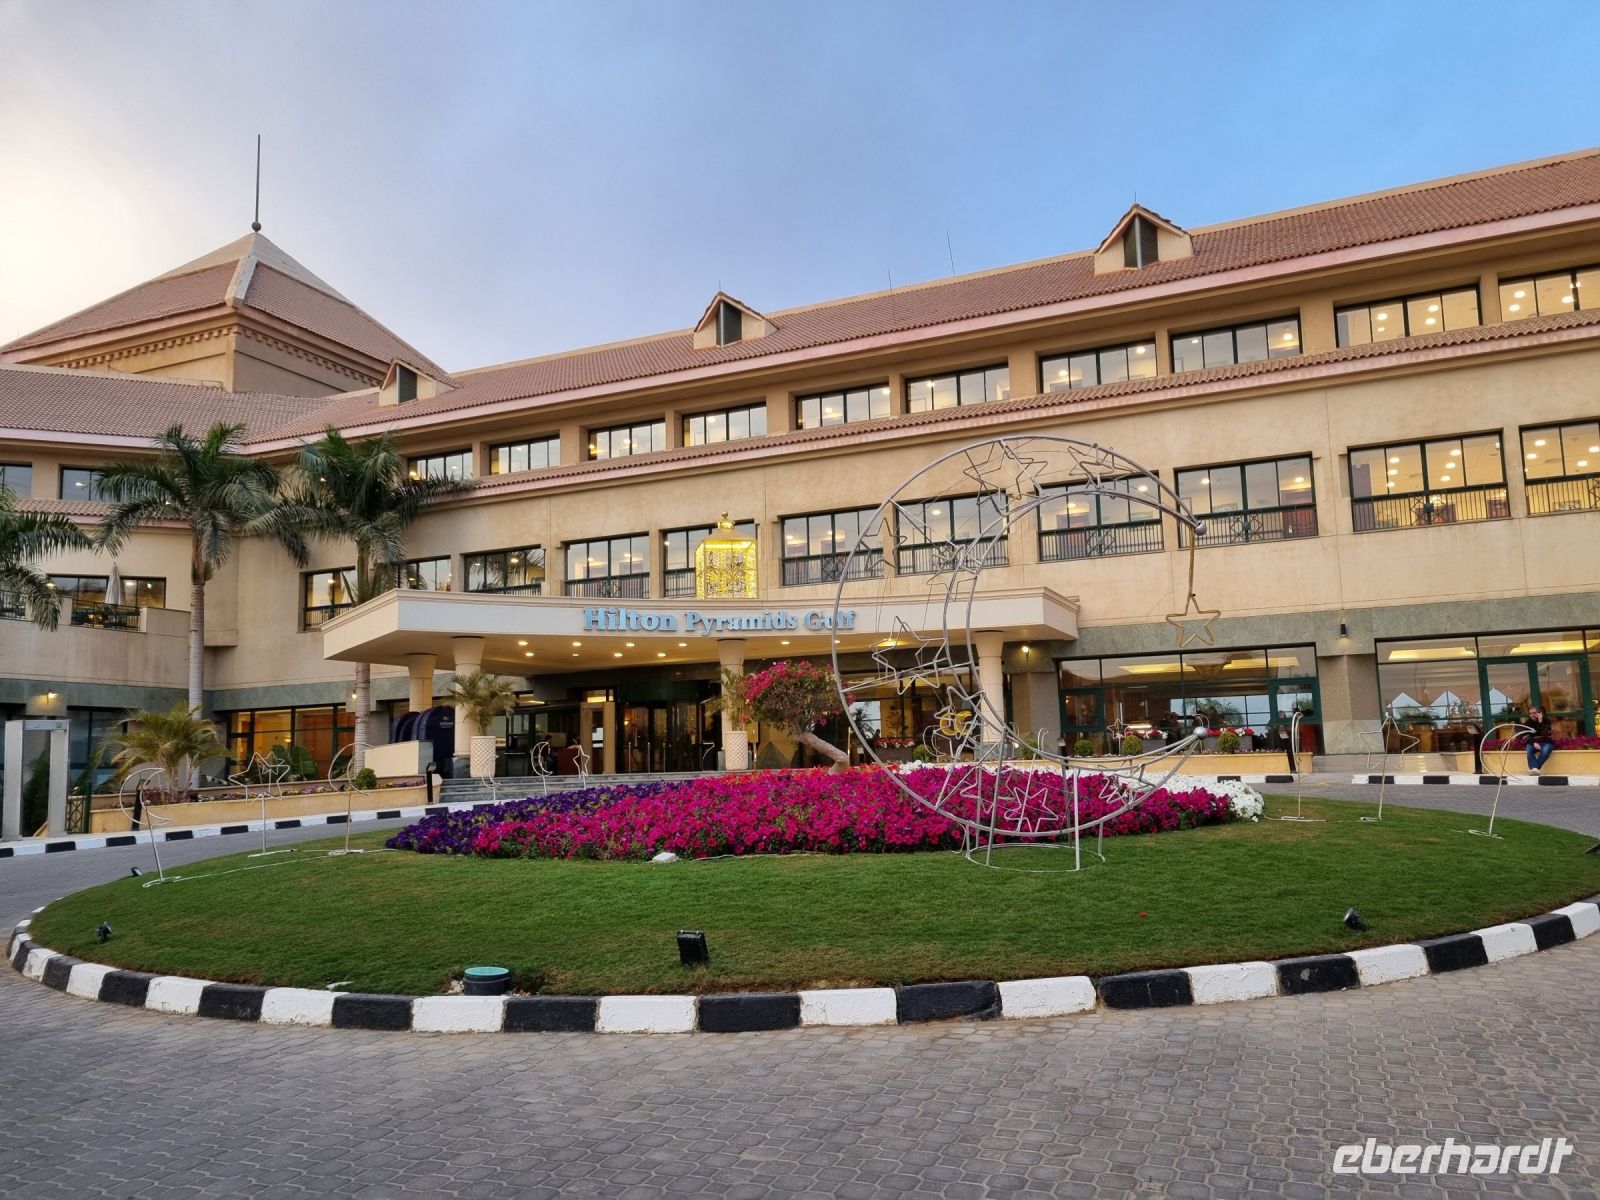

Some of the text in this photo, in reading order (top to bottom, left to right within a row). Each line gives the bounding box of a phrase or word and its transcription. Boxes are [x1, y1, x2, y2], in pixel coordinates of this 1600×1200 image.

[584, 607, 856, 636] Hilton Pyramids Golf
